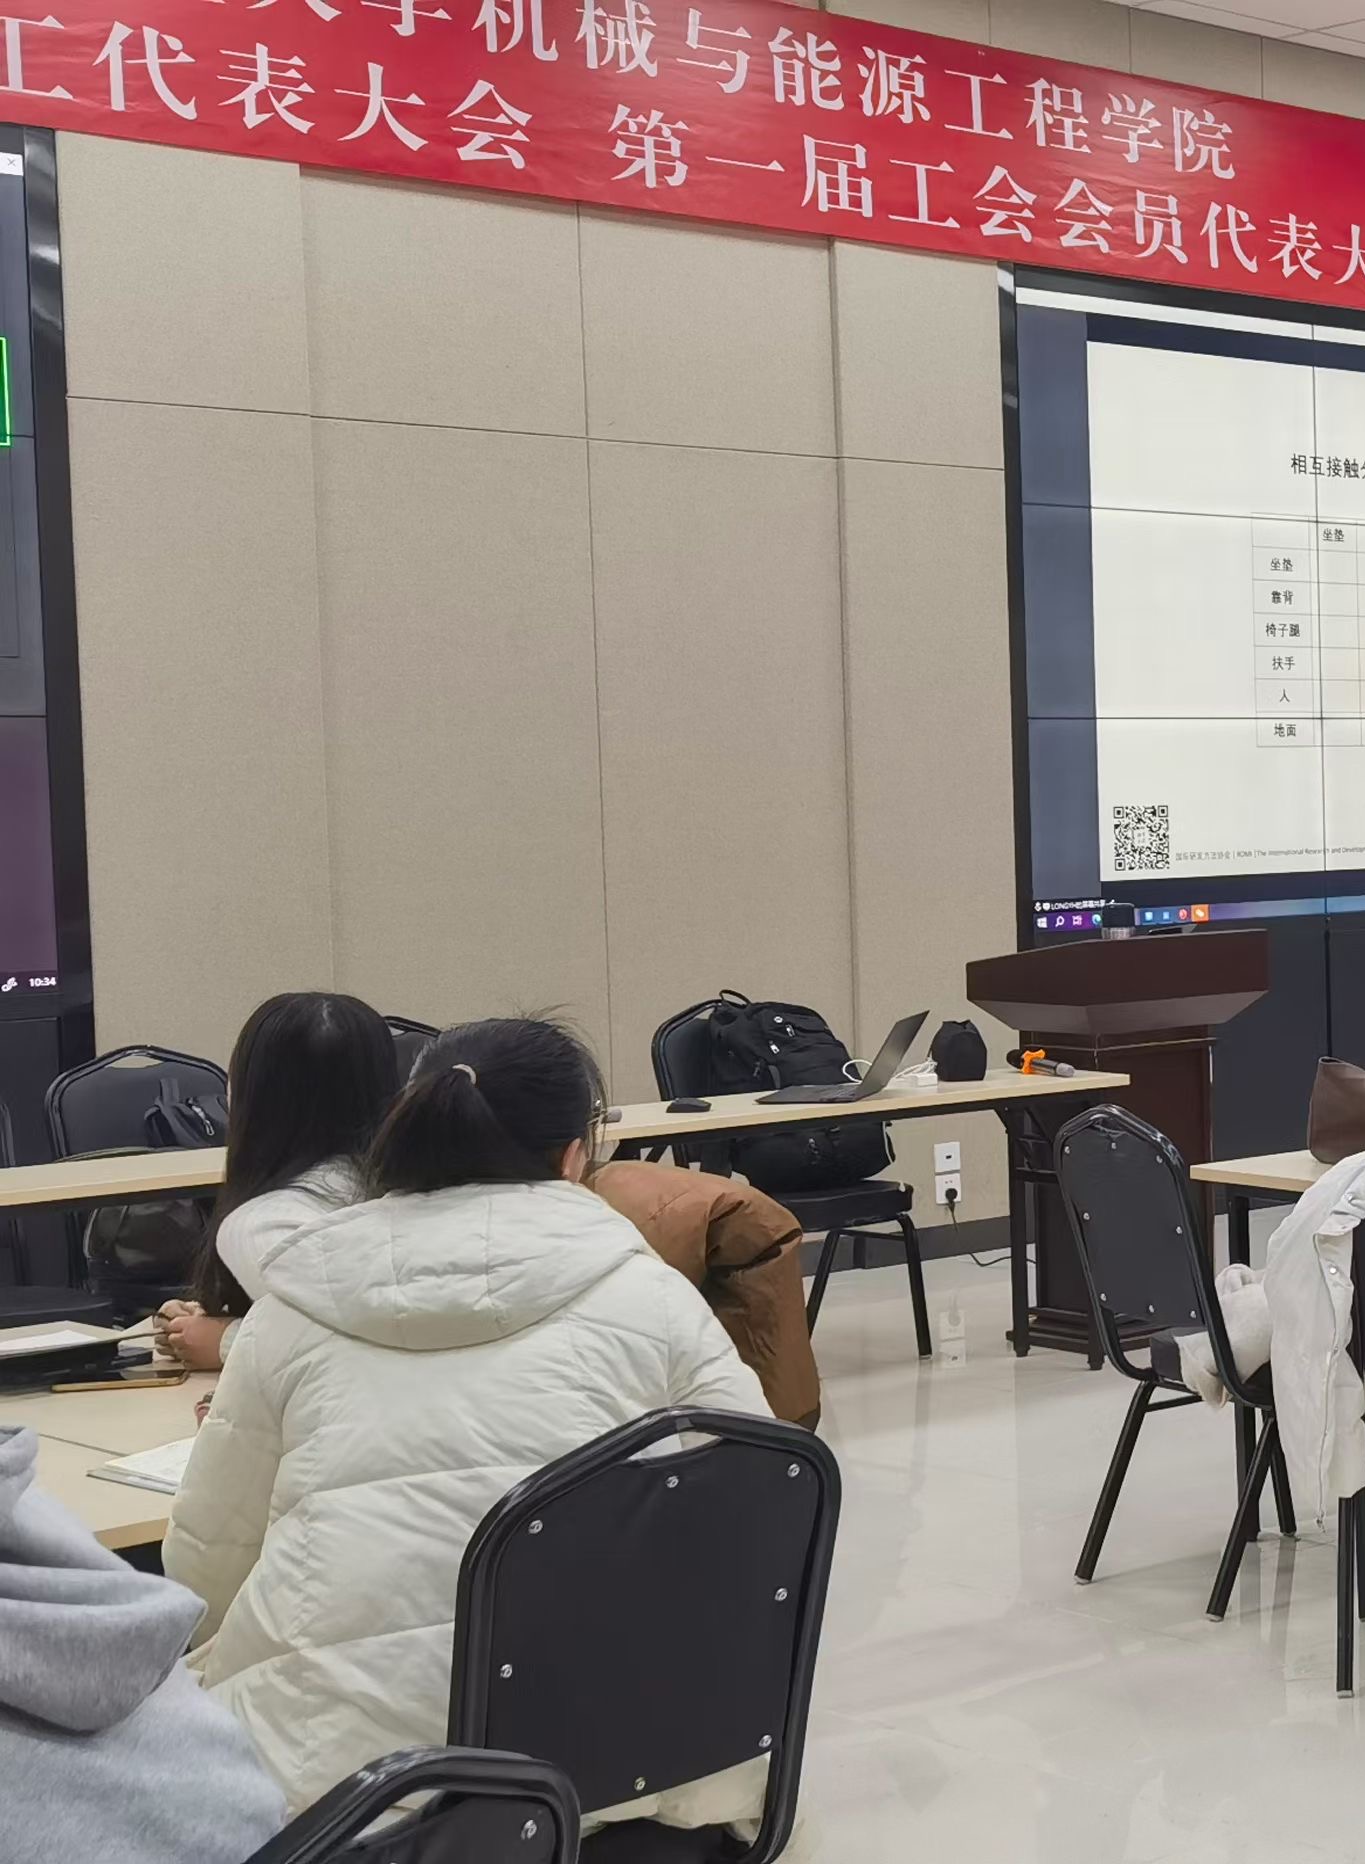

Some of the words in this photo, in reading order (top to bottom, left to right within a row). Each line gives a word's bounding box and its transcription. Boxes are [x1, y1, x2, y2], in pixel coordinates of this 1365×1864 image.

[0, 15, 532, 169] 工代表大会
[247, 0, 1236, 179] 机械与能源工程学院
[1322, 528, 1345, 543] 坐垫
[1270, 557, 1293, 572] 坐垫
[1271, 590, 1294, 605] 靠背
[1265, 622, 1301, 638] 椅子腿
[1272, 656, 1296, 671] 扶手
[1279, 688, 1291, 703] 人
[1273, 723, 1297, 738] 地面
[29, 976, 57, 988] 10:34
